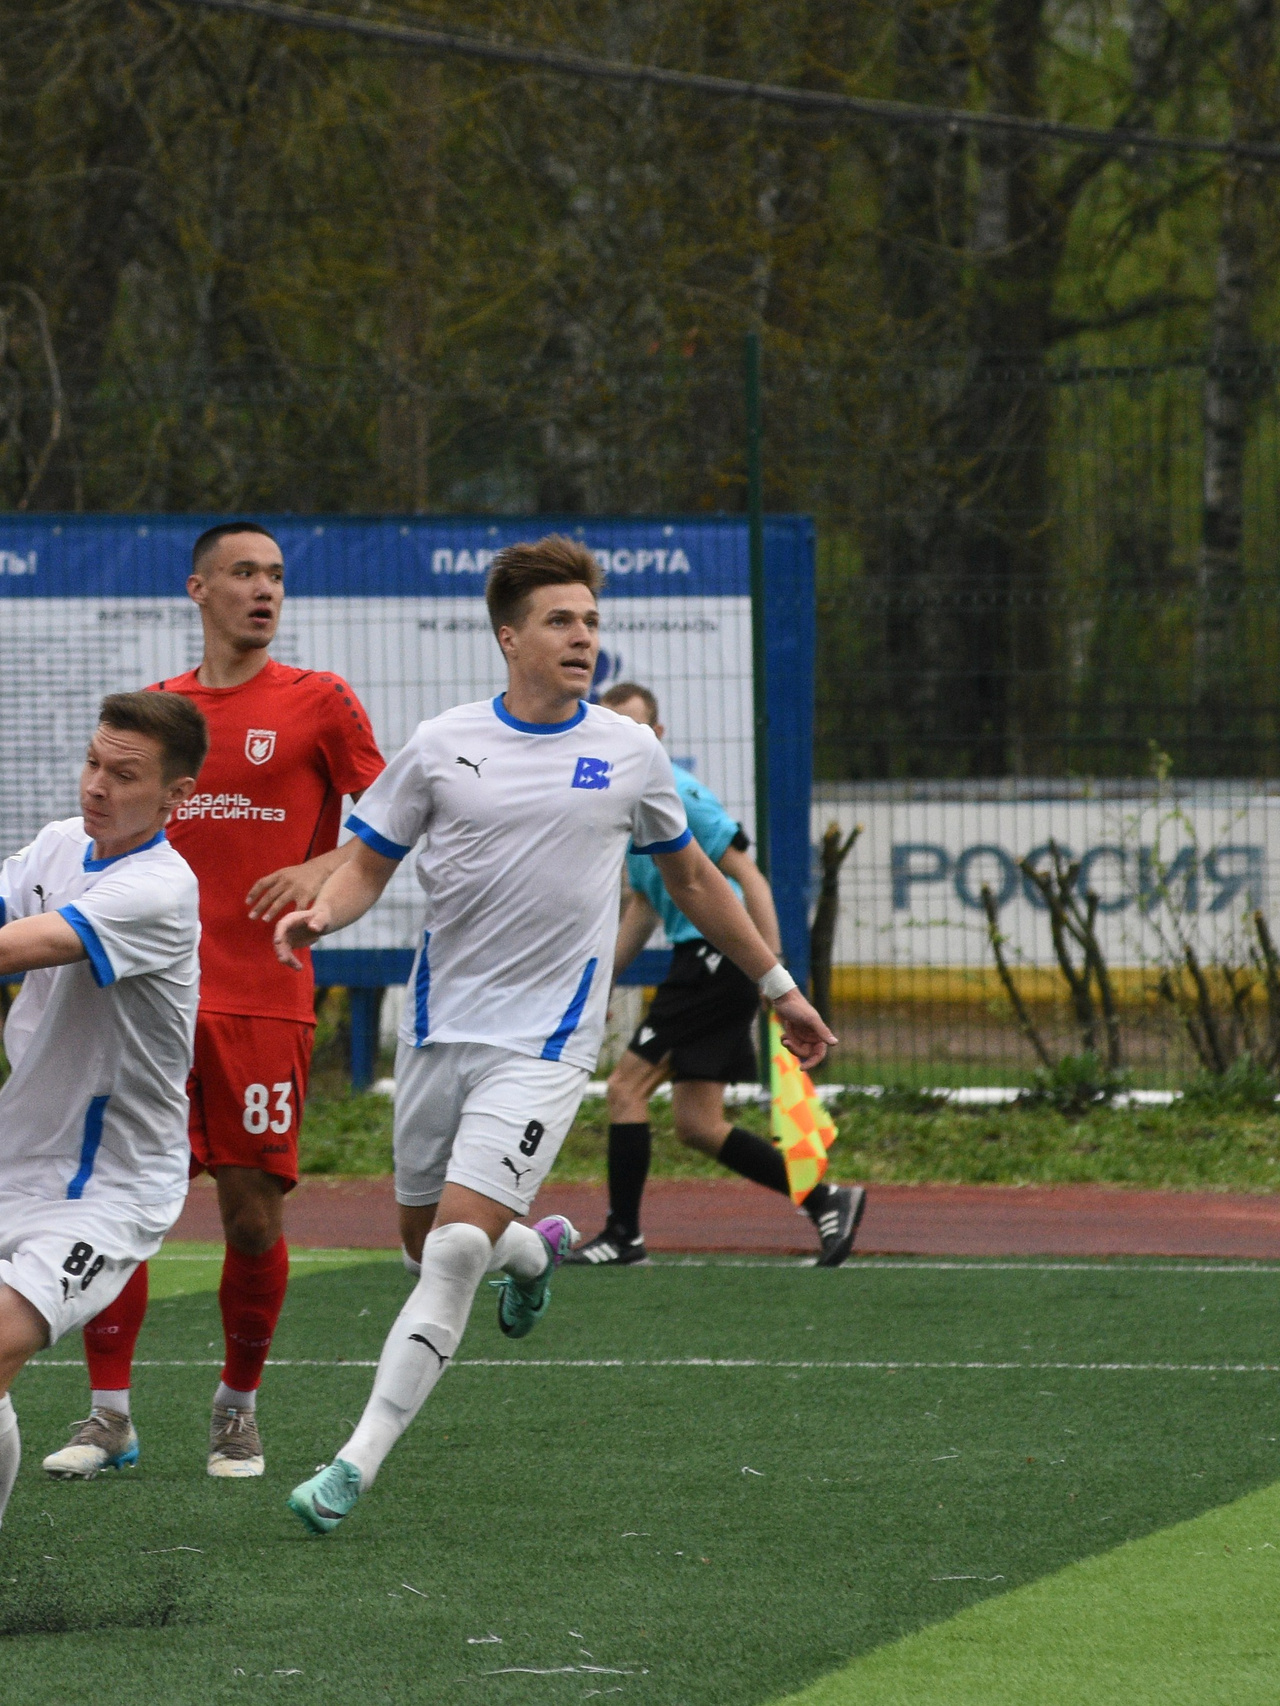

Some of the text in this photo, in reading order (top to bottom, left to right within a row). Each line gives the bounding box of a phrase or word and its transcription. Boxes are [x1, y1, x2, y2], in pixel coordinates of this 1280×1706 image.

[591, 549, 690, 575] ПОРТА
[176, 806, 286, 822] ОРГСИНТЕЗ
[890, 842, 1266, 914] РОССИЯ
[242, 1081, 293, 1135] 83
[519, 1119, 545, 1157] 9
